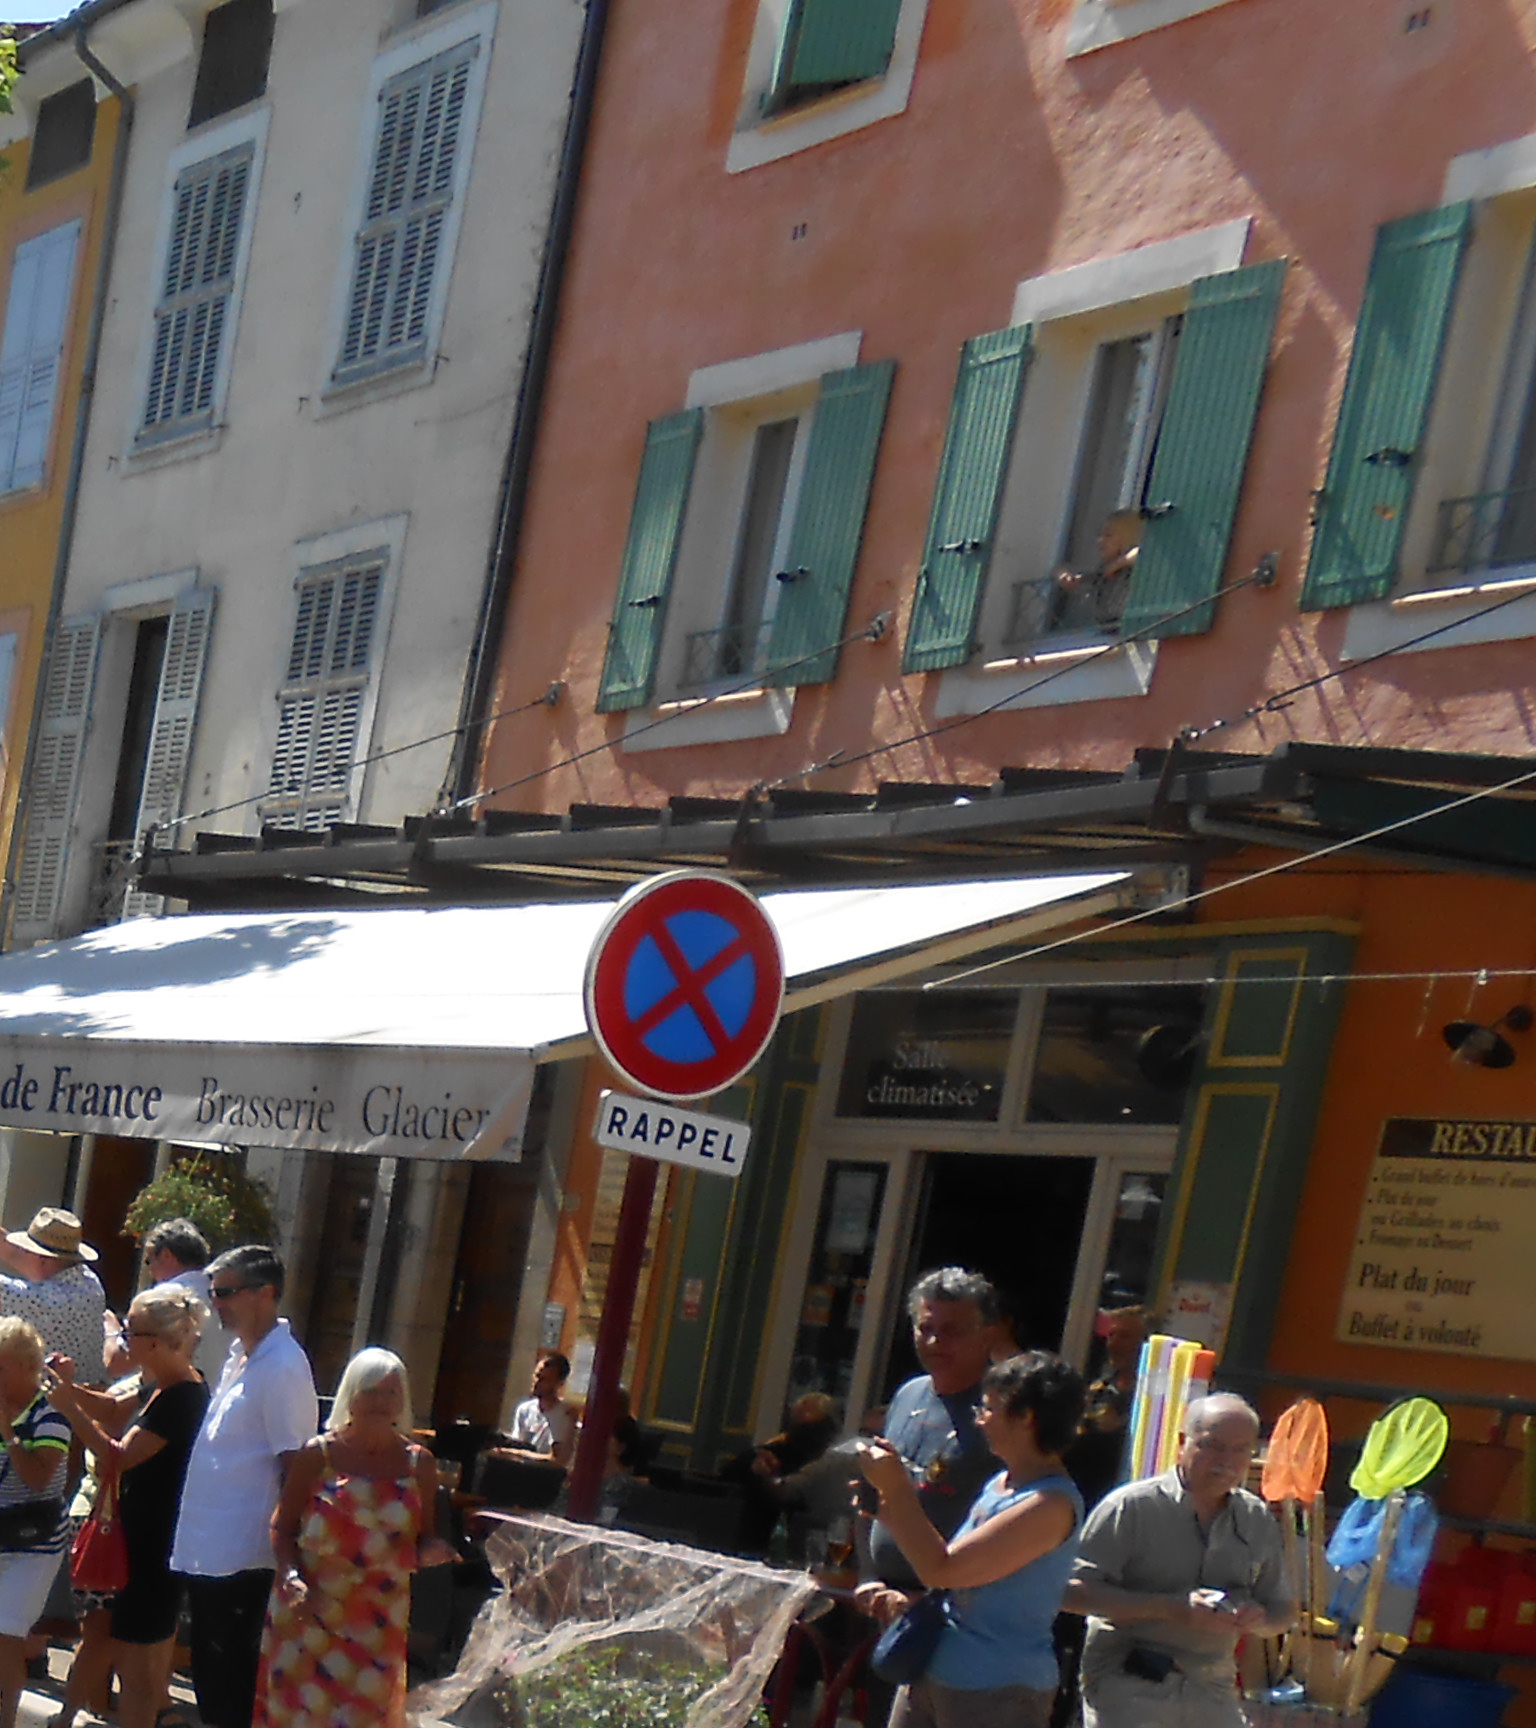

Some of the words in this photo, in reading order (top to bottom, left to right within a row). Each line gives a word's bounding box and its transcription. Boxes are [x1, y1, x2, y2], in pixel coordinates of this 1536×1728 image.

[0, 1063, 39, 1112] de
[46, 1066, 163, 1122] France
[195, 1076, 335, 1133] Brasserie
[362, 1085, 491, 1142] Glacier
[867, 1075, 980, 1107] climatisée
[607, 1105, 736, 1164] RAPPEL
[1358, 1262, 1398, 1290] Plat
[1403, 1266, 1428, 1293] du
[1429, 1268, 1476, 1298] jour
[1348, 1310, 1400, 1340] Buffet
[1403, 1317, 1415, 1342] à
[1419, 1318, 1482, 1348] volonté
